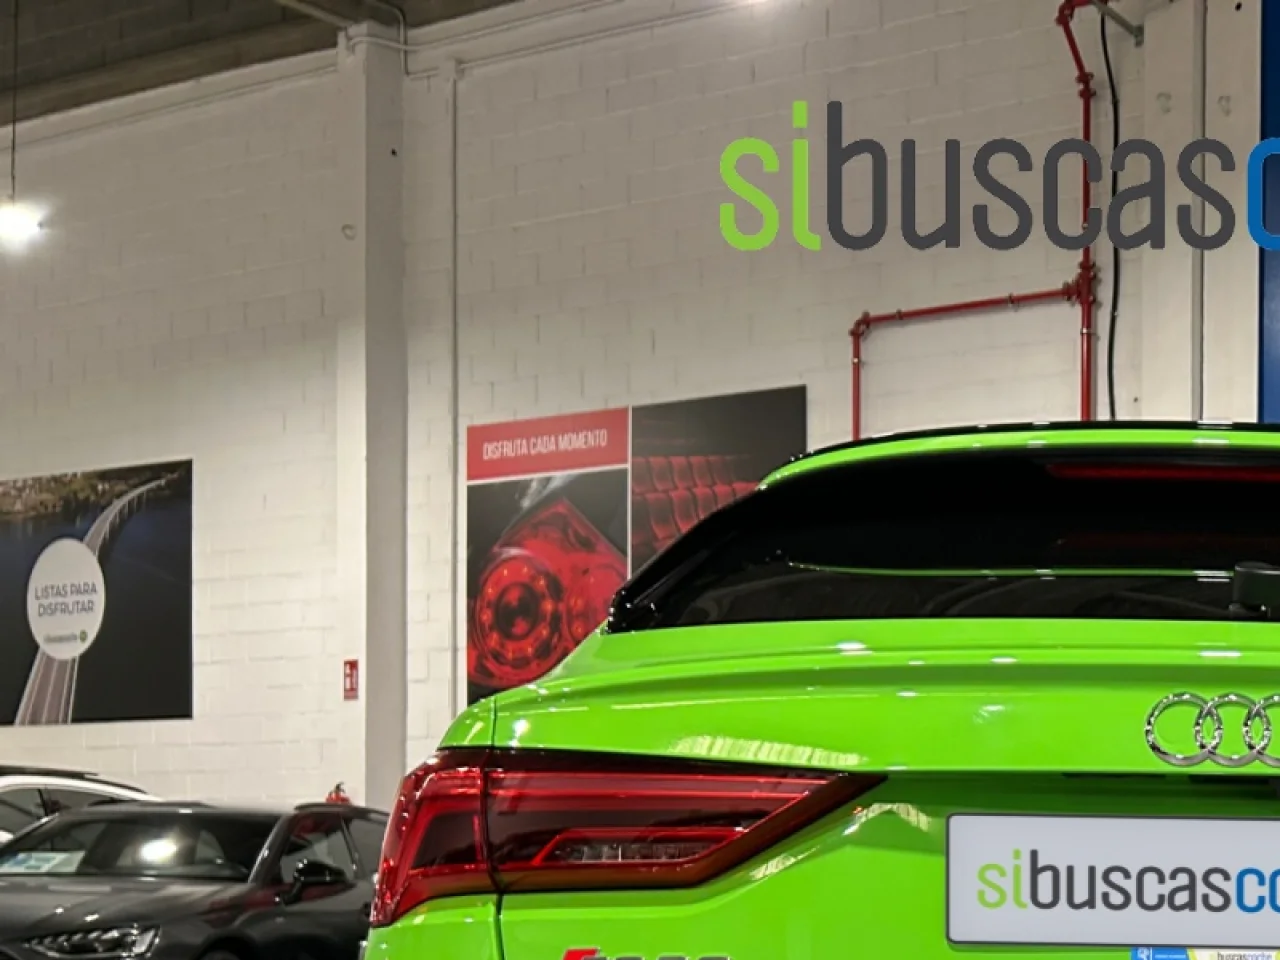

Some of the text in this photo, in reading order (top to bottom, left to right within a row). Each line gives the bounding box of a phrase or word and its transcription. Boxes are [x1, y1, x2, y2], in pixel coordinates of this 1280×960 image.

[483, 428, 608, 460] DISFRUTA CADA MOMENTO
[34, 582, 98, 600] LISTAS PARA
[38, 600, 95, 617] DISFRUTAR
